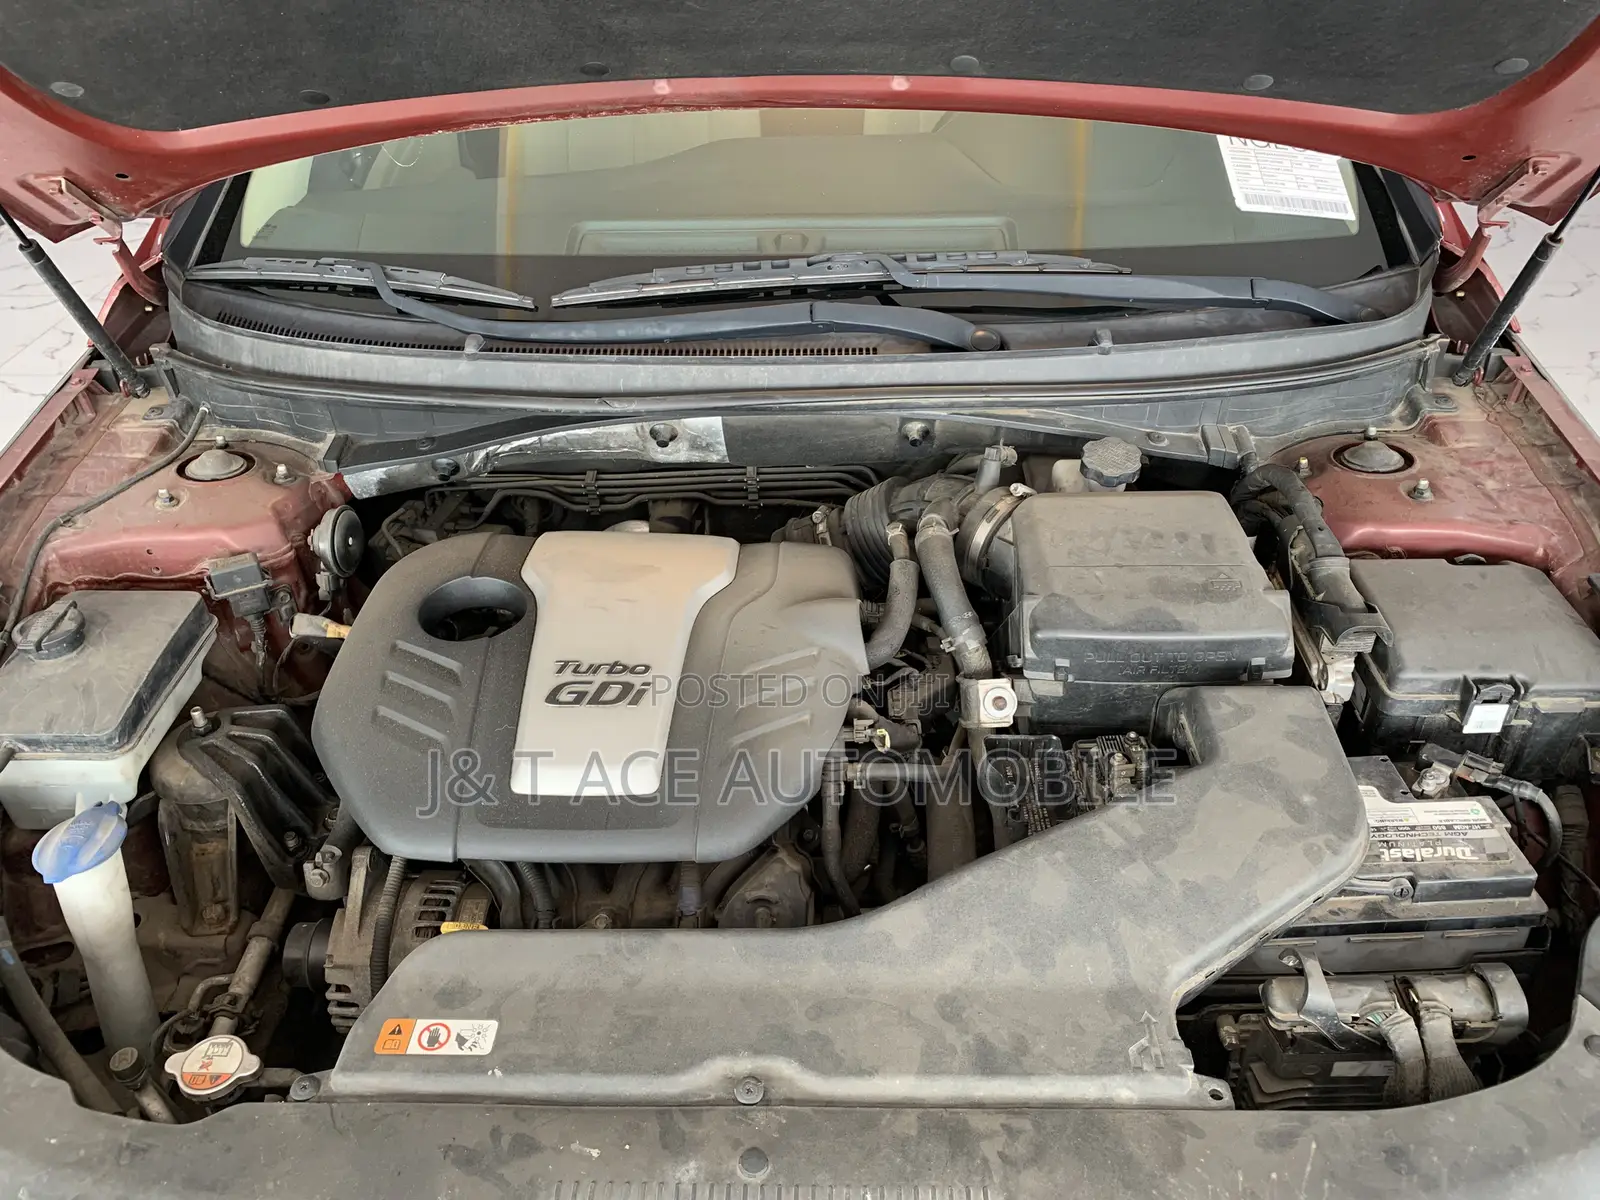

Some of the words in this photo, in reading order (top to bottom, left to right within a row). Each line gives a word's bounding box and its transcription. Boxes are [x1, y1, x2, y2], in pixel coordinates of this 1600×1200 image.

[1083, 651, 1125, 664] PULL
[1129, 651, 1164, 664] OUT
[1167, 651, 1188, 663] TO
[1193, 650, 1238, 663] OPEN
[554, 660, 653, 677] Turbo
[544, 680, 653, 707] GDi
[1370, 831, 1442, 839] TECHNOLOGY
[1377, 839, 1443, 848] PLATINUM
[1379, 845, 1480, 862] Duralast
